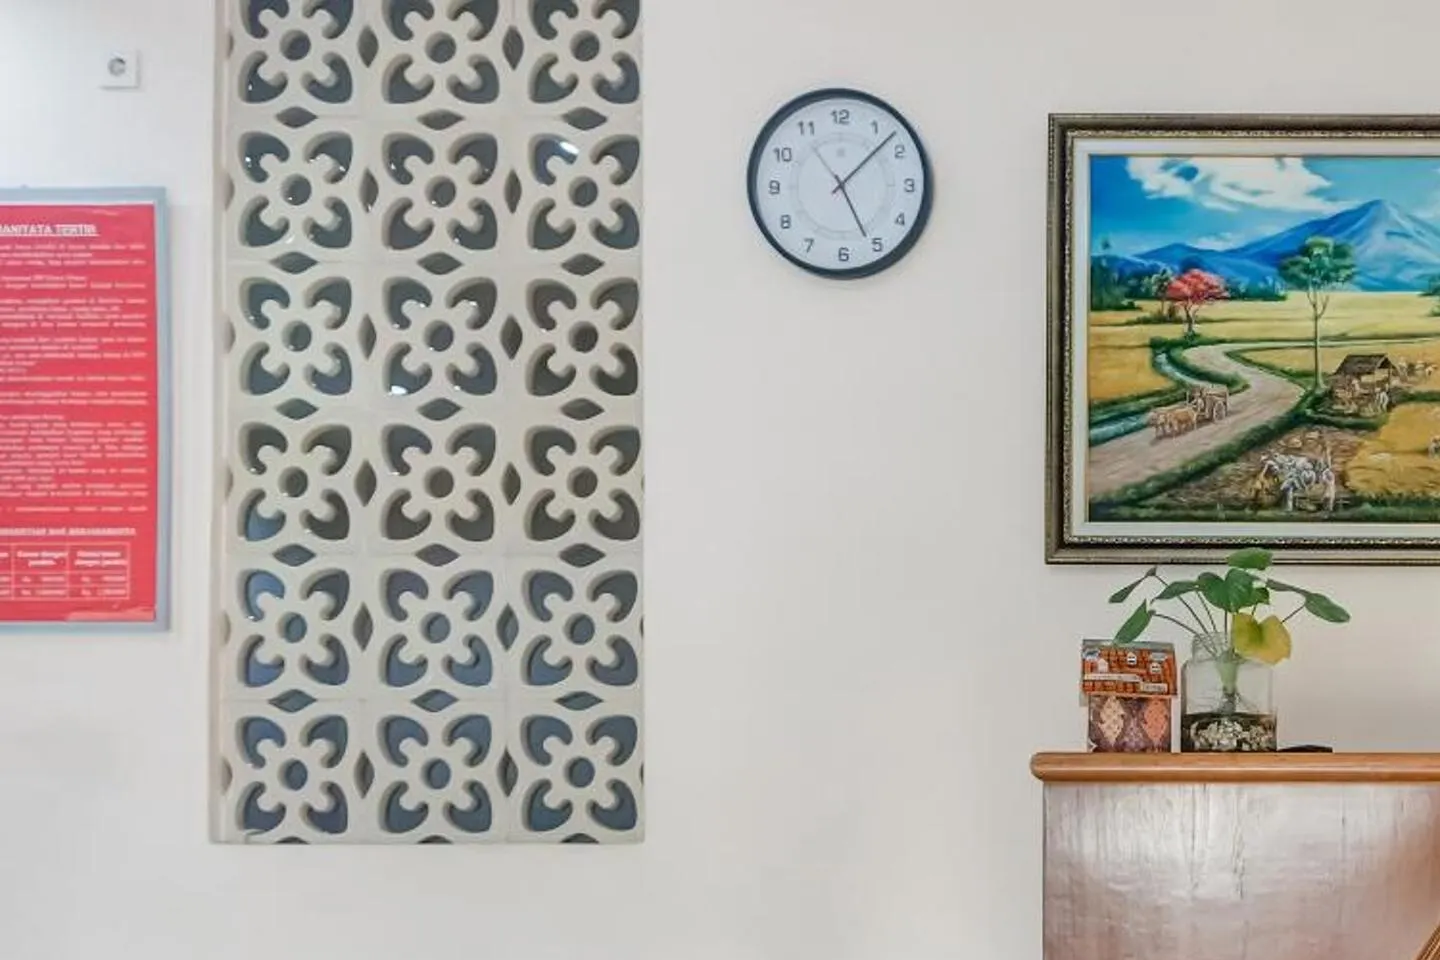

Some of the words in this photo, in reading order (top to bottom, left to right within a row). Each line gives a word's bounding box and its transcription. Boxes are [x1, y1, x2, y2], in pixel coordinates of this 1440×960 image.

[830, 109, 850, 124] 12
[797, 121, 815, 135] 11
[871, 121, 879, 134] 1
[773, 147, 792, 162] 10
[894, 145, 905, 159] 2
[768, 180, 781, 195] 9
[904, 178, 915, 193] 3
[780, 215, 791, 229] 8
[894, 213, 905, 226] 4
[803, 238, 815, 253] 7
[872, 237, 883, 252] 5
[838, 247, 849, 262] 6
